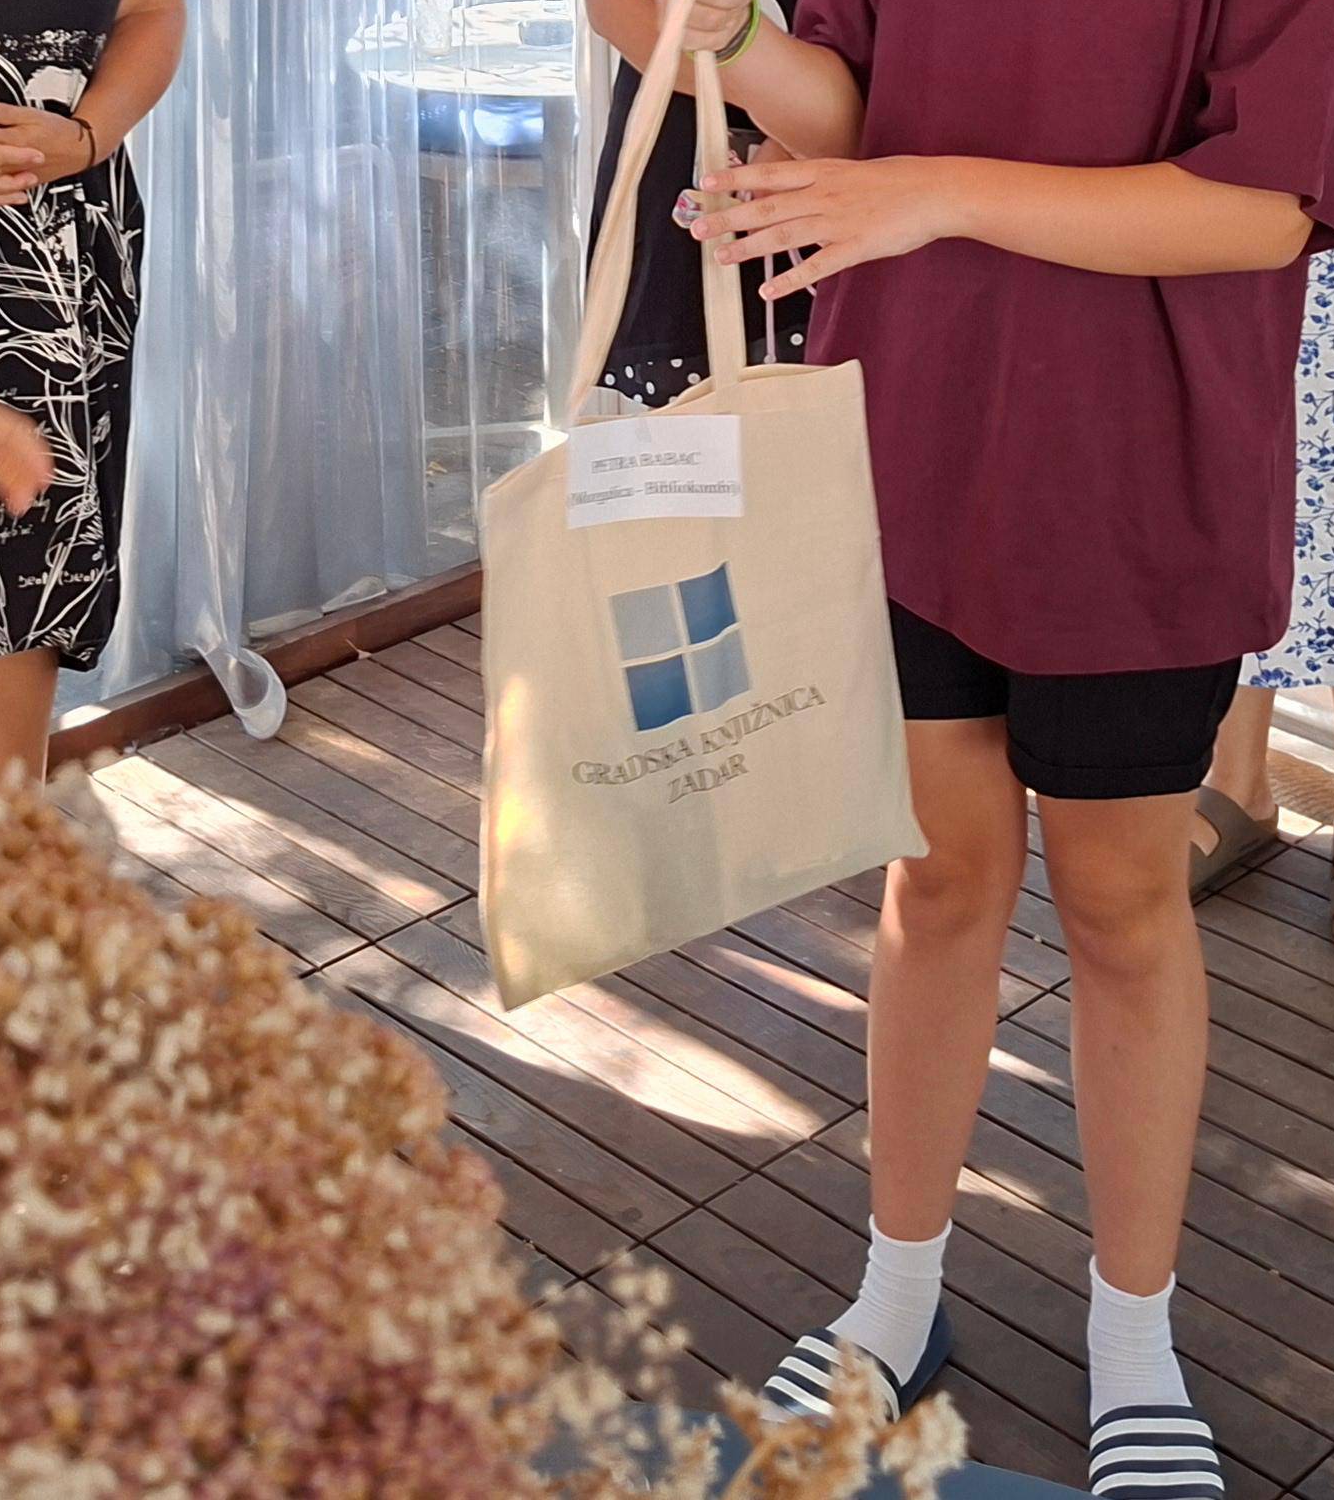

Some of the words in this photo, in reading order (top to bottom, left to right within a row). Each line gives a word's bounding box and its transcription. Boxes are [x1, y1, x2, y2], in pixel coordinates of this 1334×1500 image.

[572, 737, 695, 785] GRADSKA
[700, 685, 827, 756] KNJIŽNICA
[668, 753, 750, 804] ZADAR
